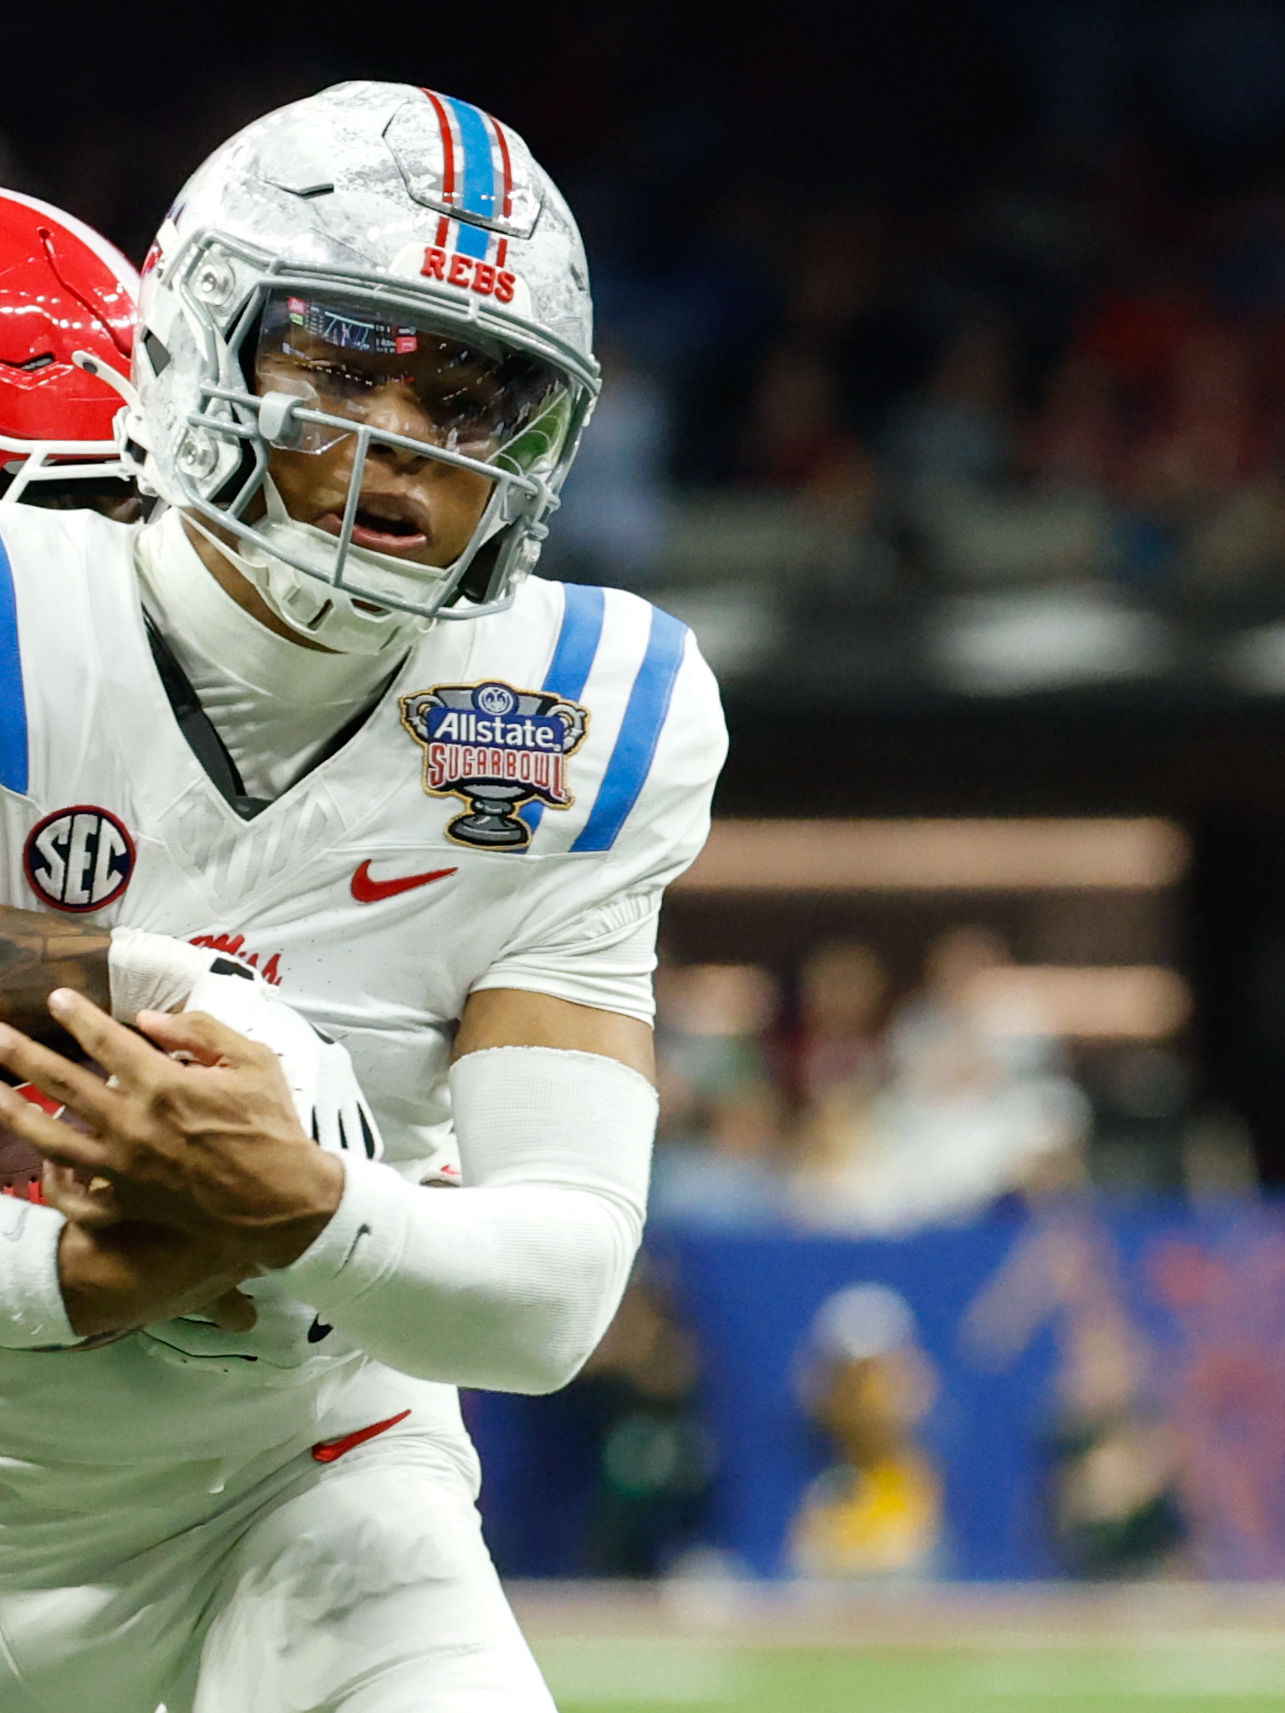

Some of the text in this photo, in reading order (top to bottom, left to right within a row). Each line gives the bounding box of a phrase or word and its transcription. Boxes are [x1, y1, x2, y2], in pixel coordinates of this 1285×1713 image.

[420, 246, 516, 304] REBS
[433, 712, 555, 749] Allstate
[33, 812, 128, 905] SEC
